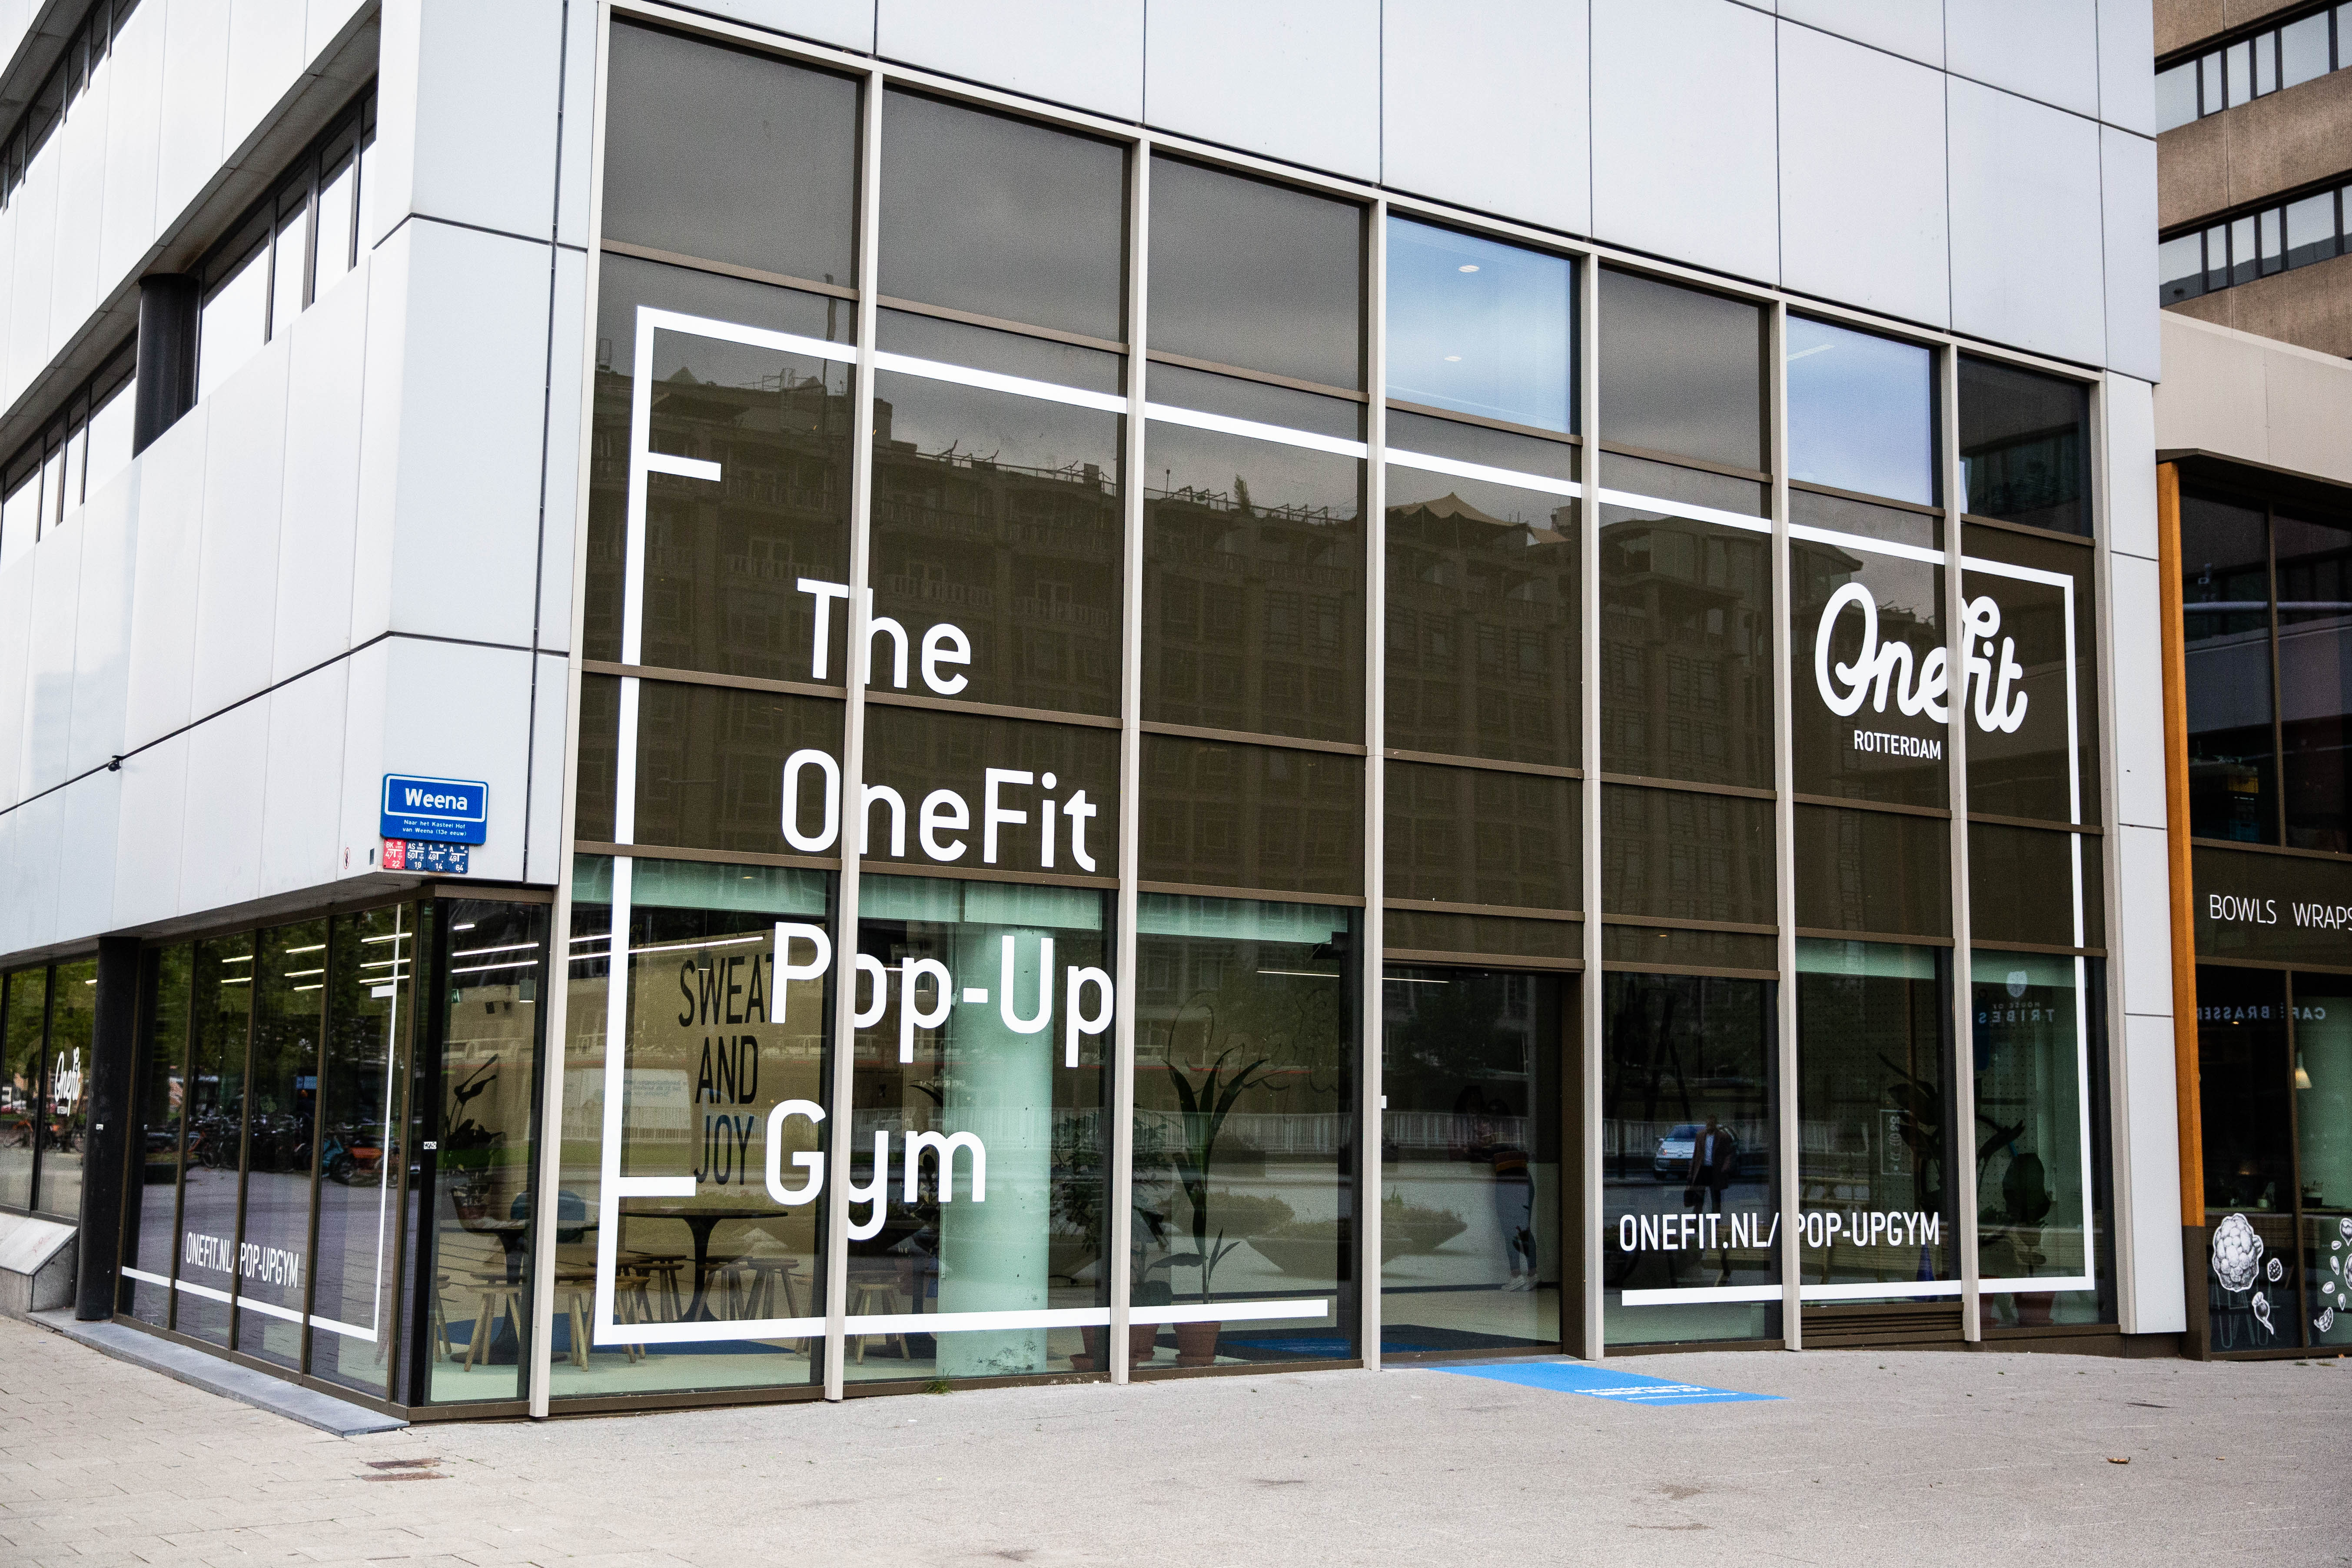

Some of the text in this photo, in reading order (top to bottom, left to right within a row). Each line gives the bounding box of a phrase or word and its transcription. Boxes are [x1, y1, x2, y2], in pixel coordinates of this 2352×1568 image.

[797, 578, 971, 695] The
[1854, 730, 1941, 760] ROTTERDAM
[405, 788, 468, 811] Weena
[782, 748, 1096, 873] OneFit
[2209, 894, 2277, 924] BOWLS
[771, 921, 1114, 1068] Pop-Up
[695, 1035, 759, 1104] AND
[694, 1114, 754, 1186] JOY
[765, 1099, 987, 1240] Gym
